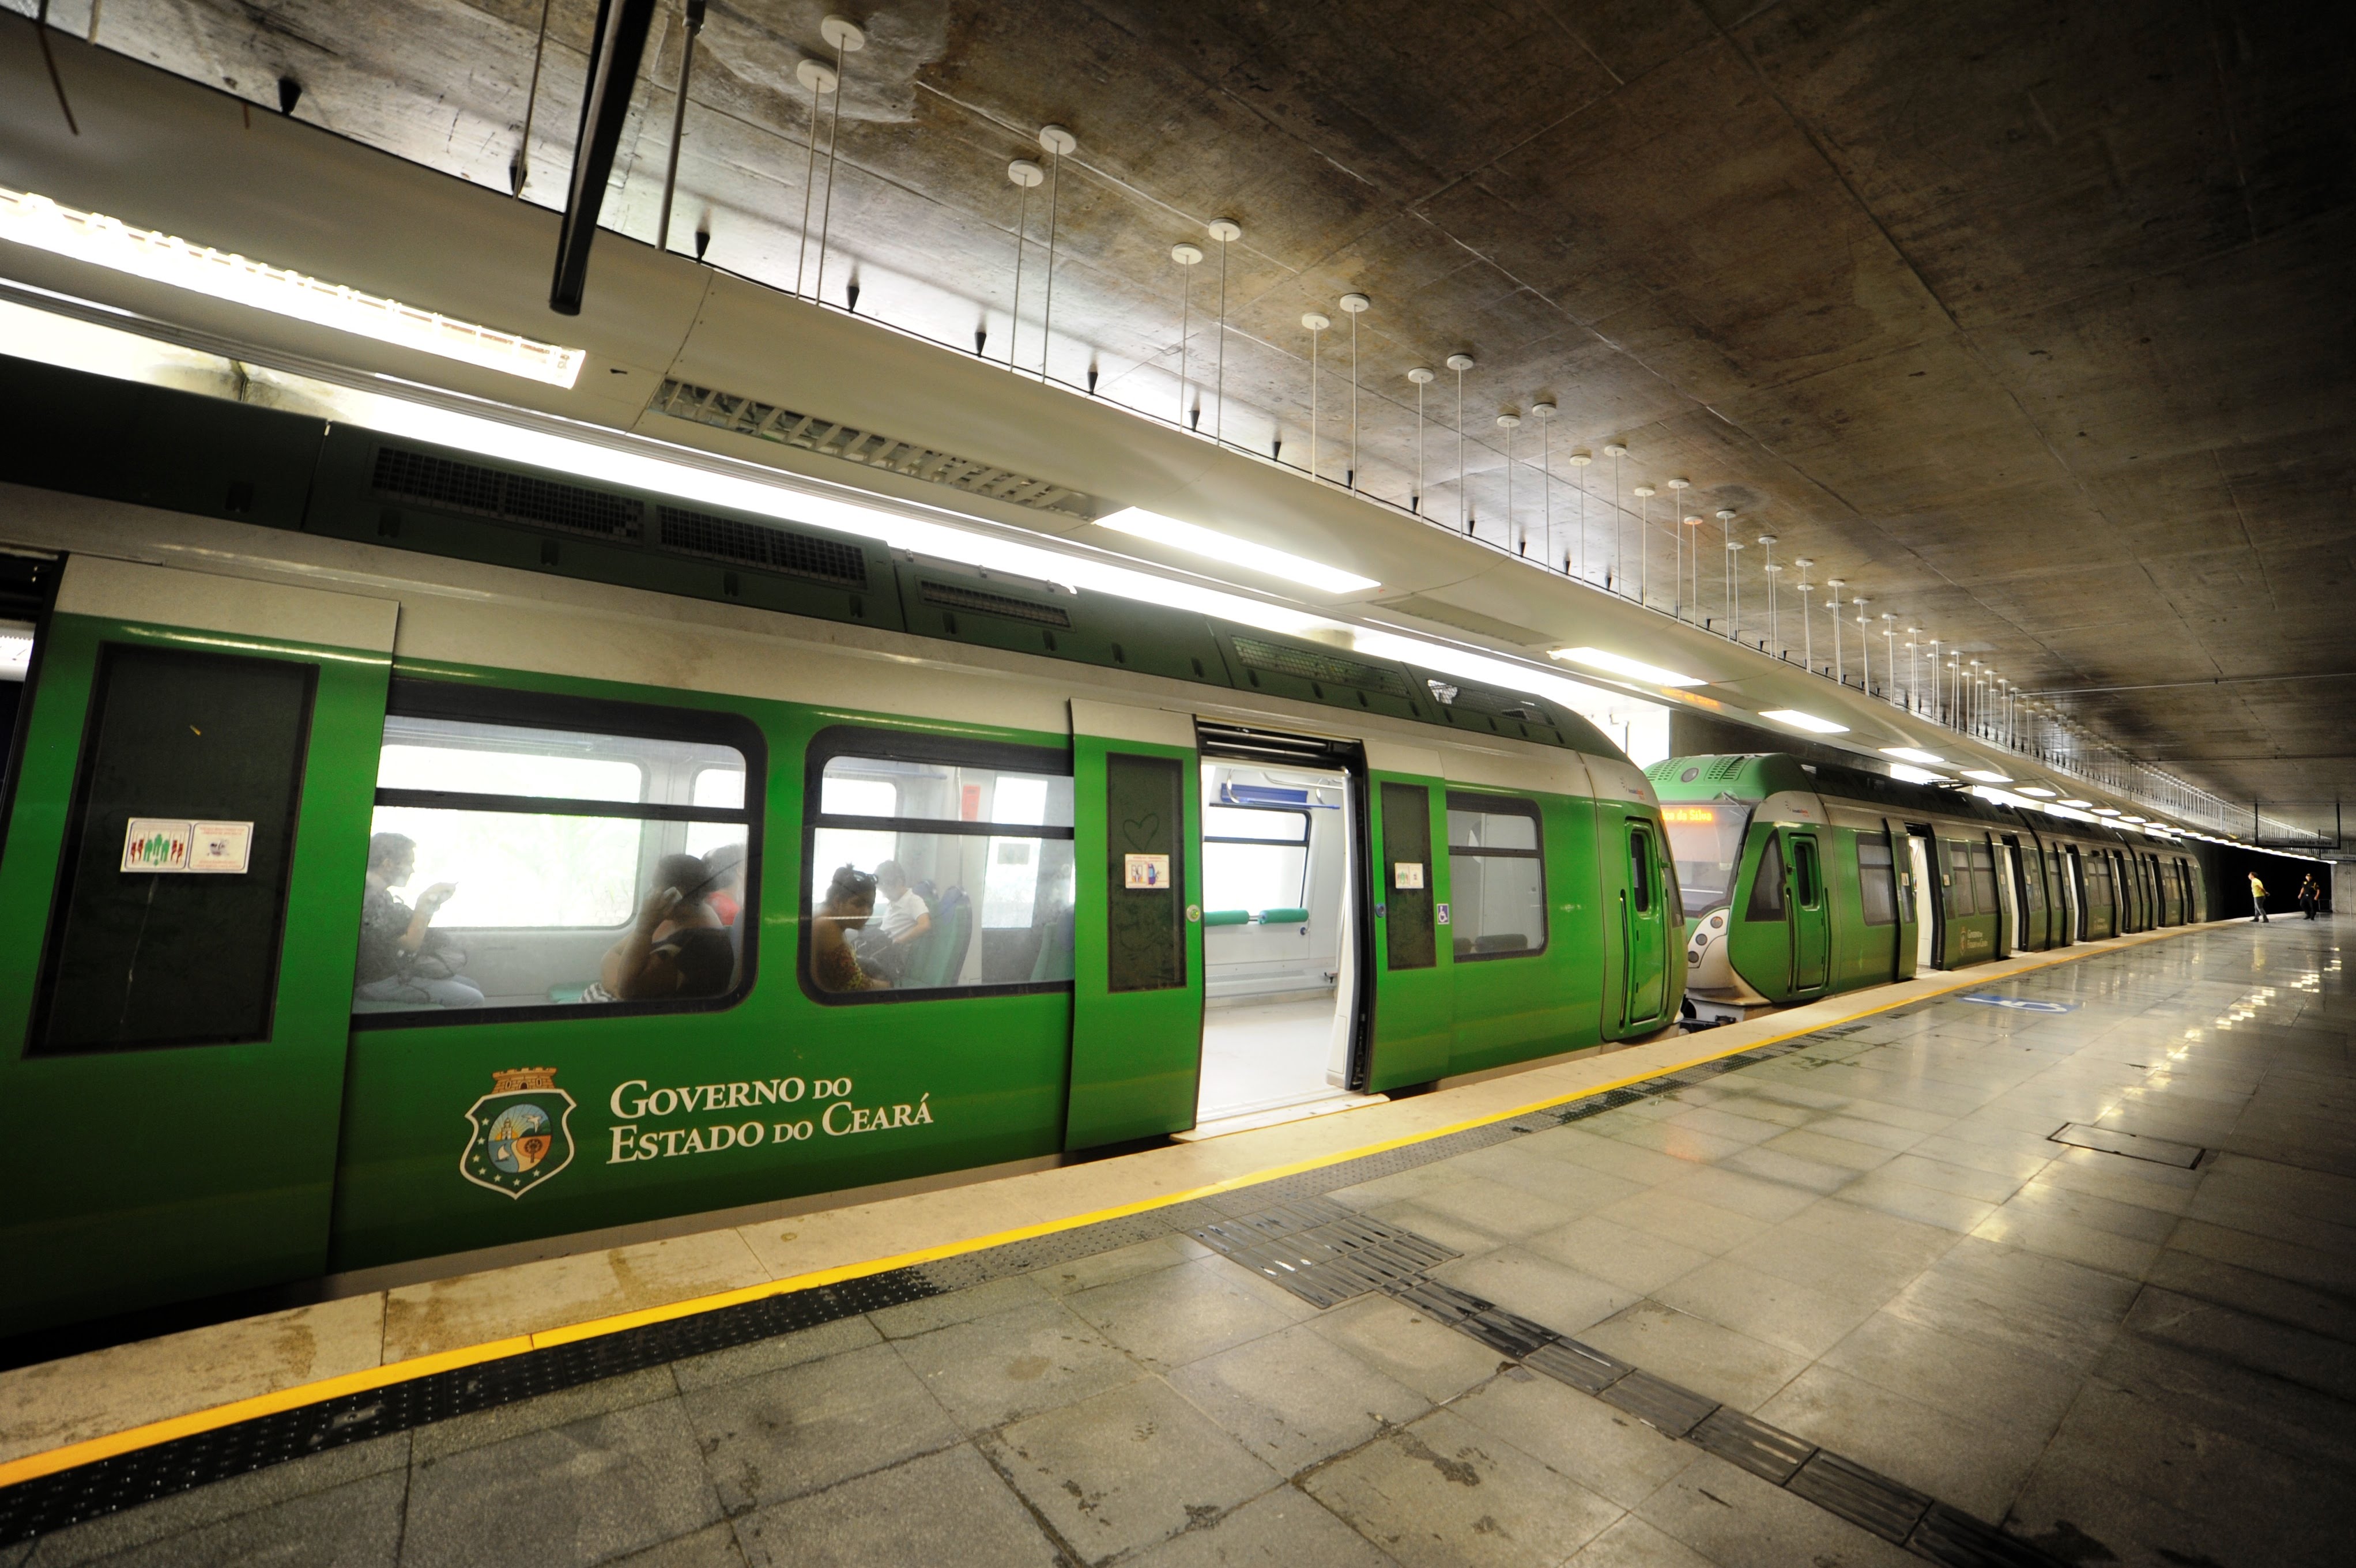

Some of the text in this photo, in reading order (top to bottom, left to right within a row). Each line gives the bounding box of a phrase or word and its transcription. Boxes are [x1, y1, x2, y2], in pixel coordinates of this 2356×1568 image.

[1662, 808, 1712, 821] ico da Silva
